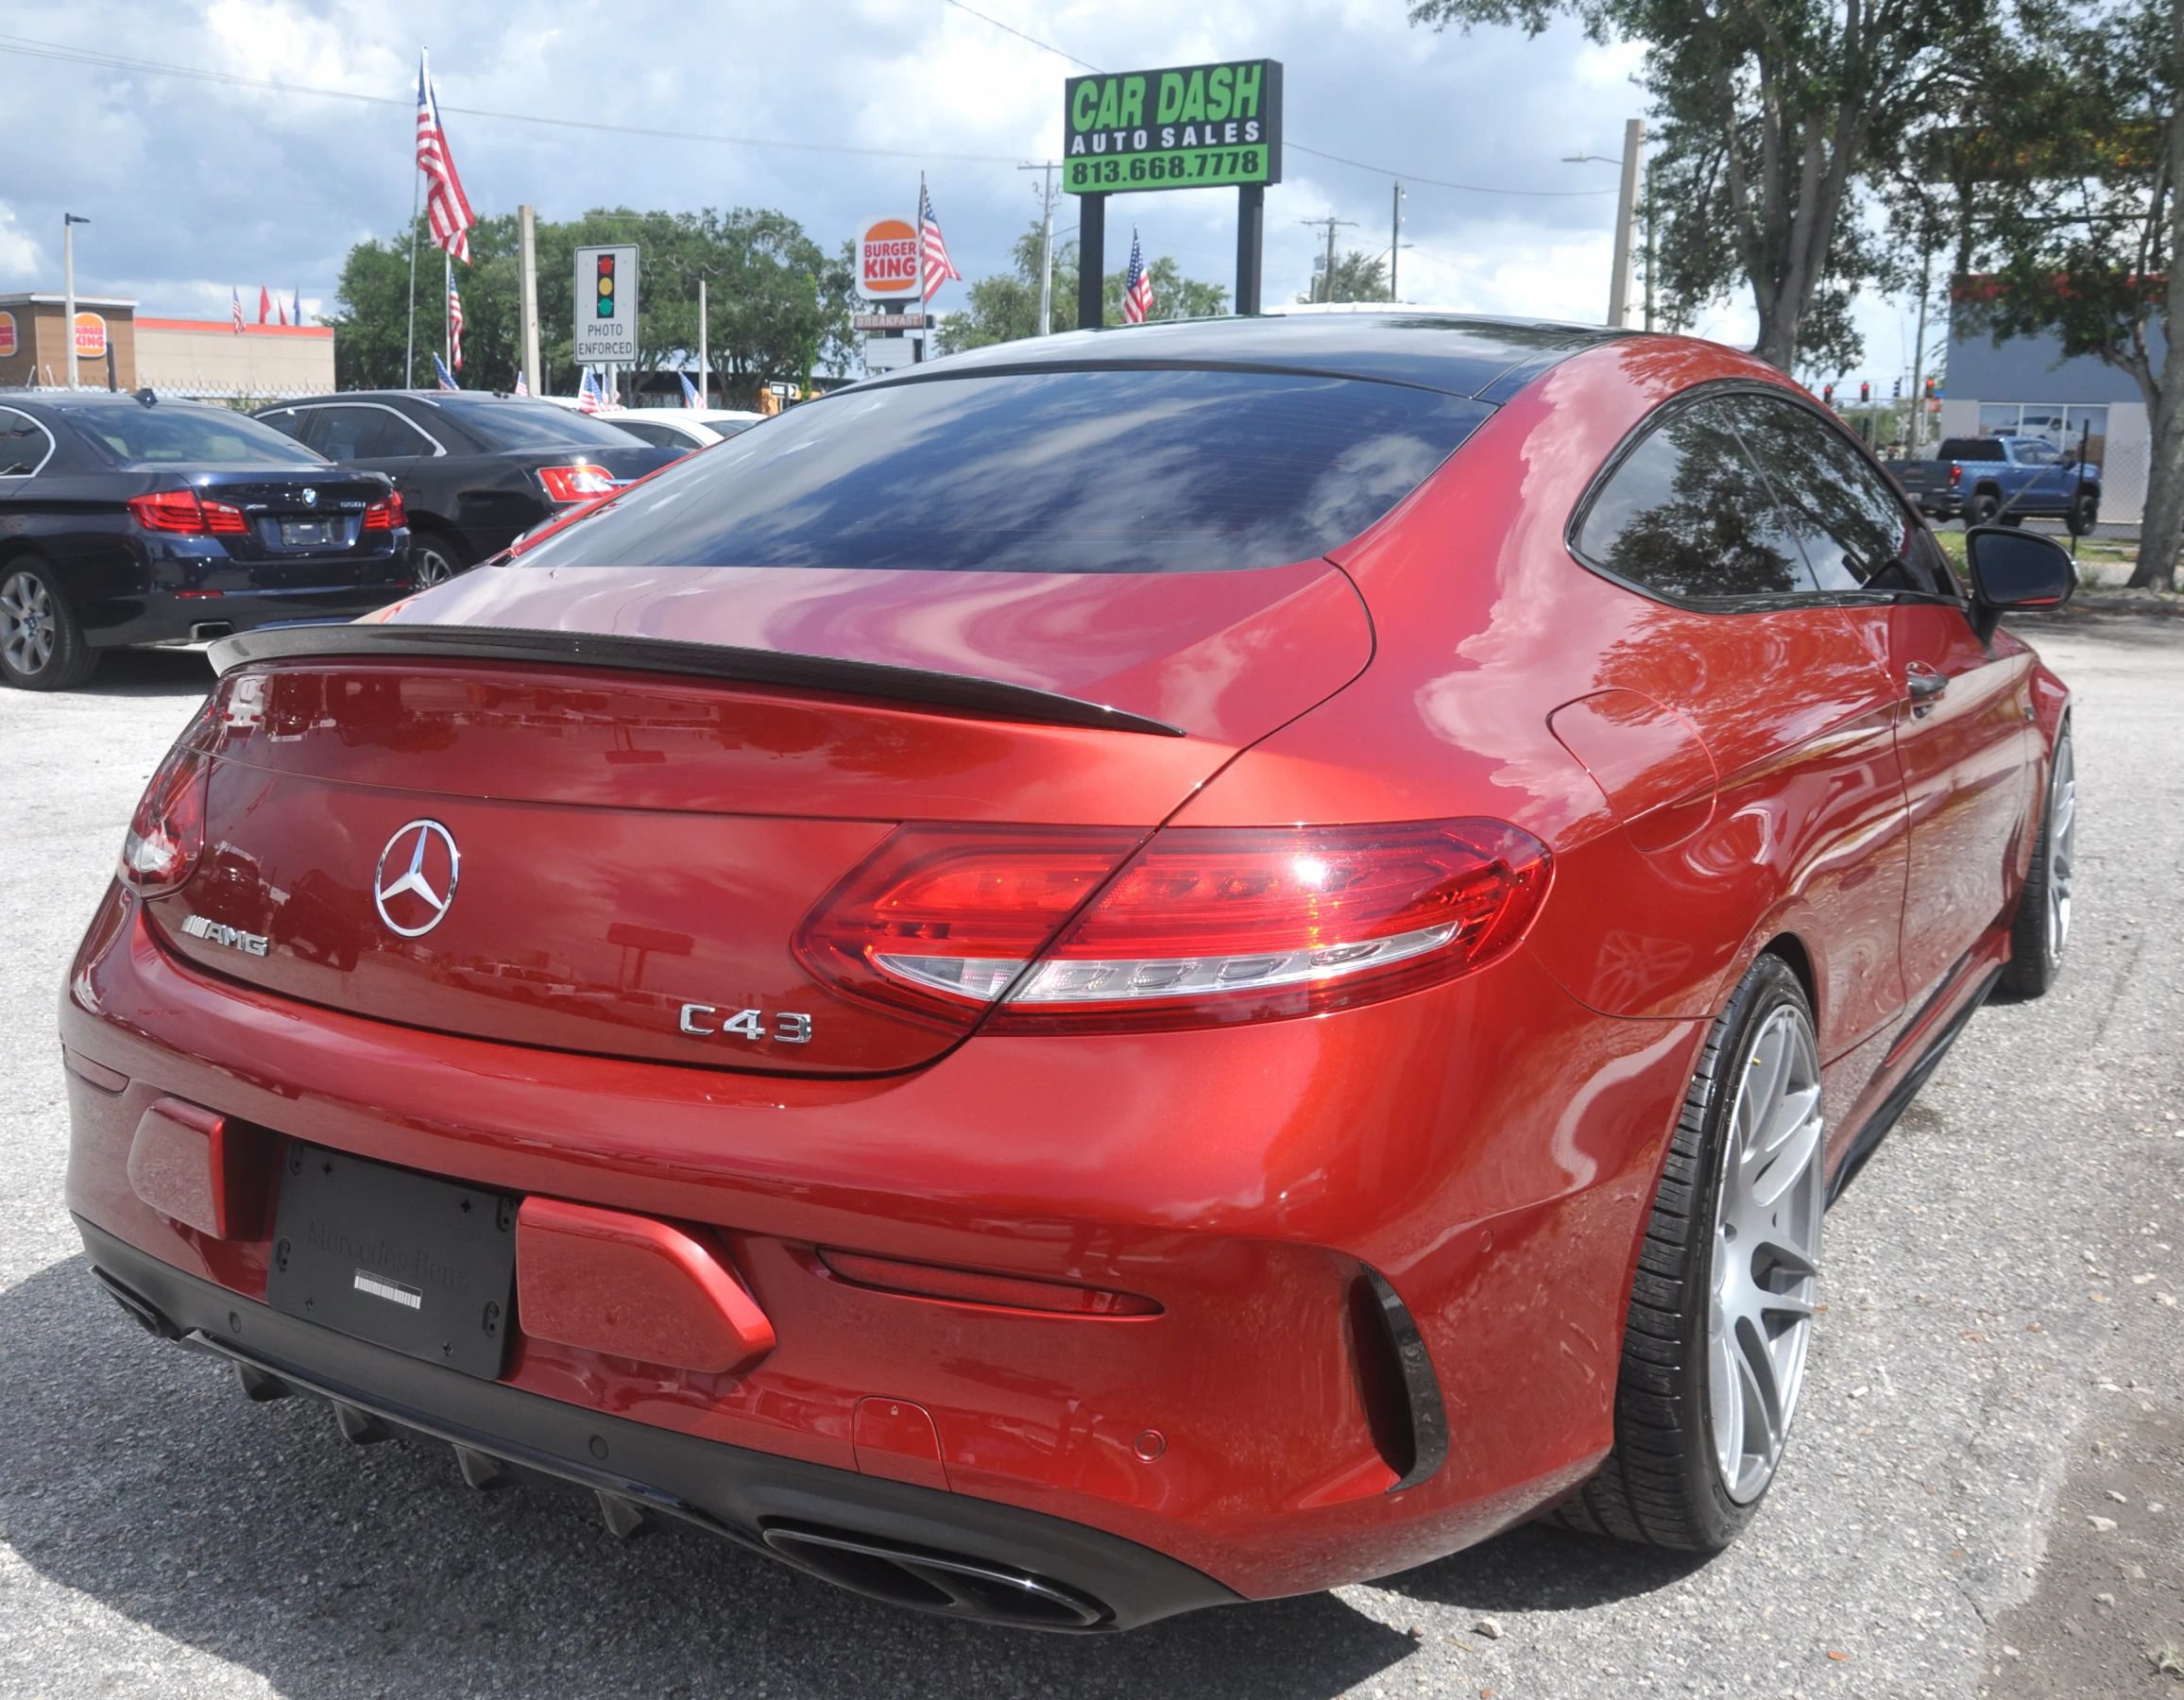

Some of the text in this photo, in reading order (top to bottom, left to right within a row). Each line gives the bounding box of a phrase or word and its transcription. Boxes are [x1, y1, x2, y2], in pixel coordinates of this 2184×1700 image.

[1072, 64, 1262, 132] CAR DASH
[1070, 121, 1260, 155] AUTO SALES
[1072, 150, 1259, 185] 813.668.7778
[863, 241, 916, 258] BURGER
[863, 256, 916, 280] KING
[587, 323, 623, 337] PHOTO
[856, 314, 919, 328] BREAKFAST
[578, 341, 633, 356] ENFORCED
